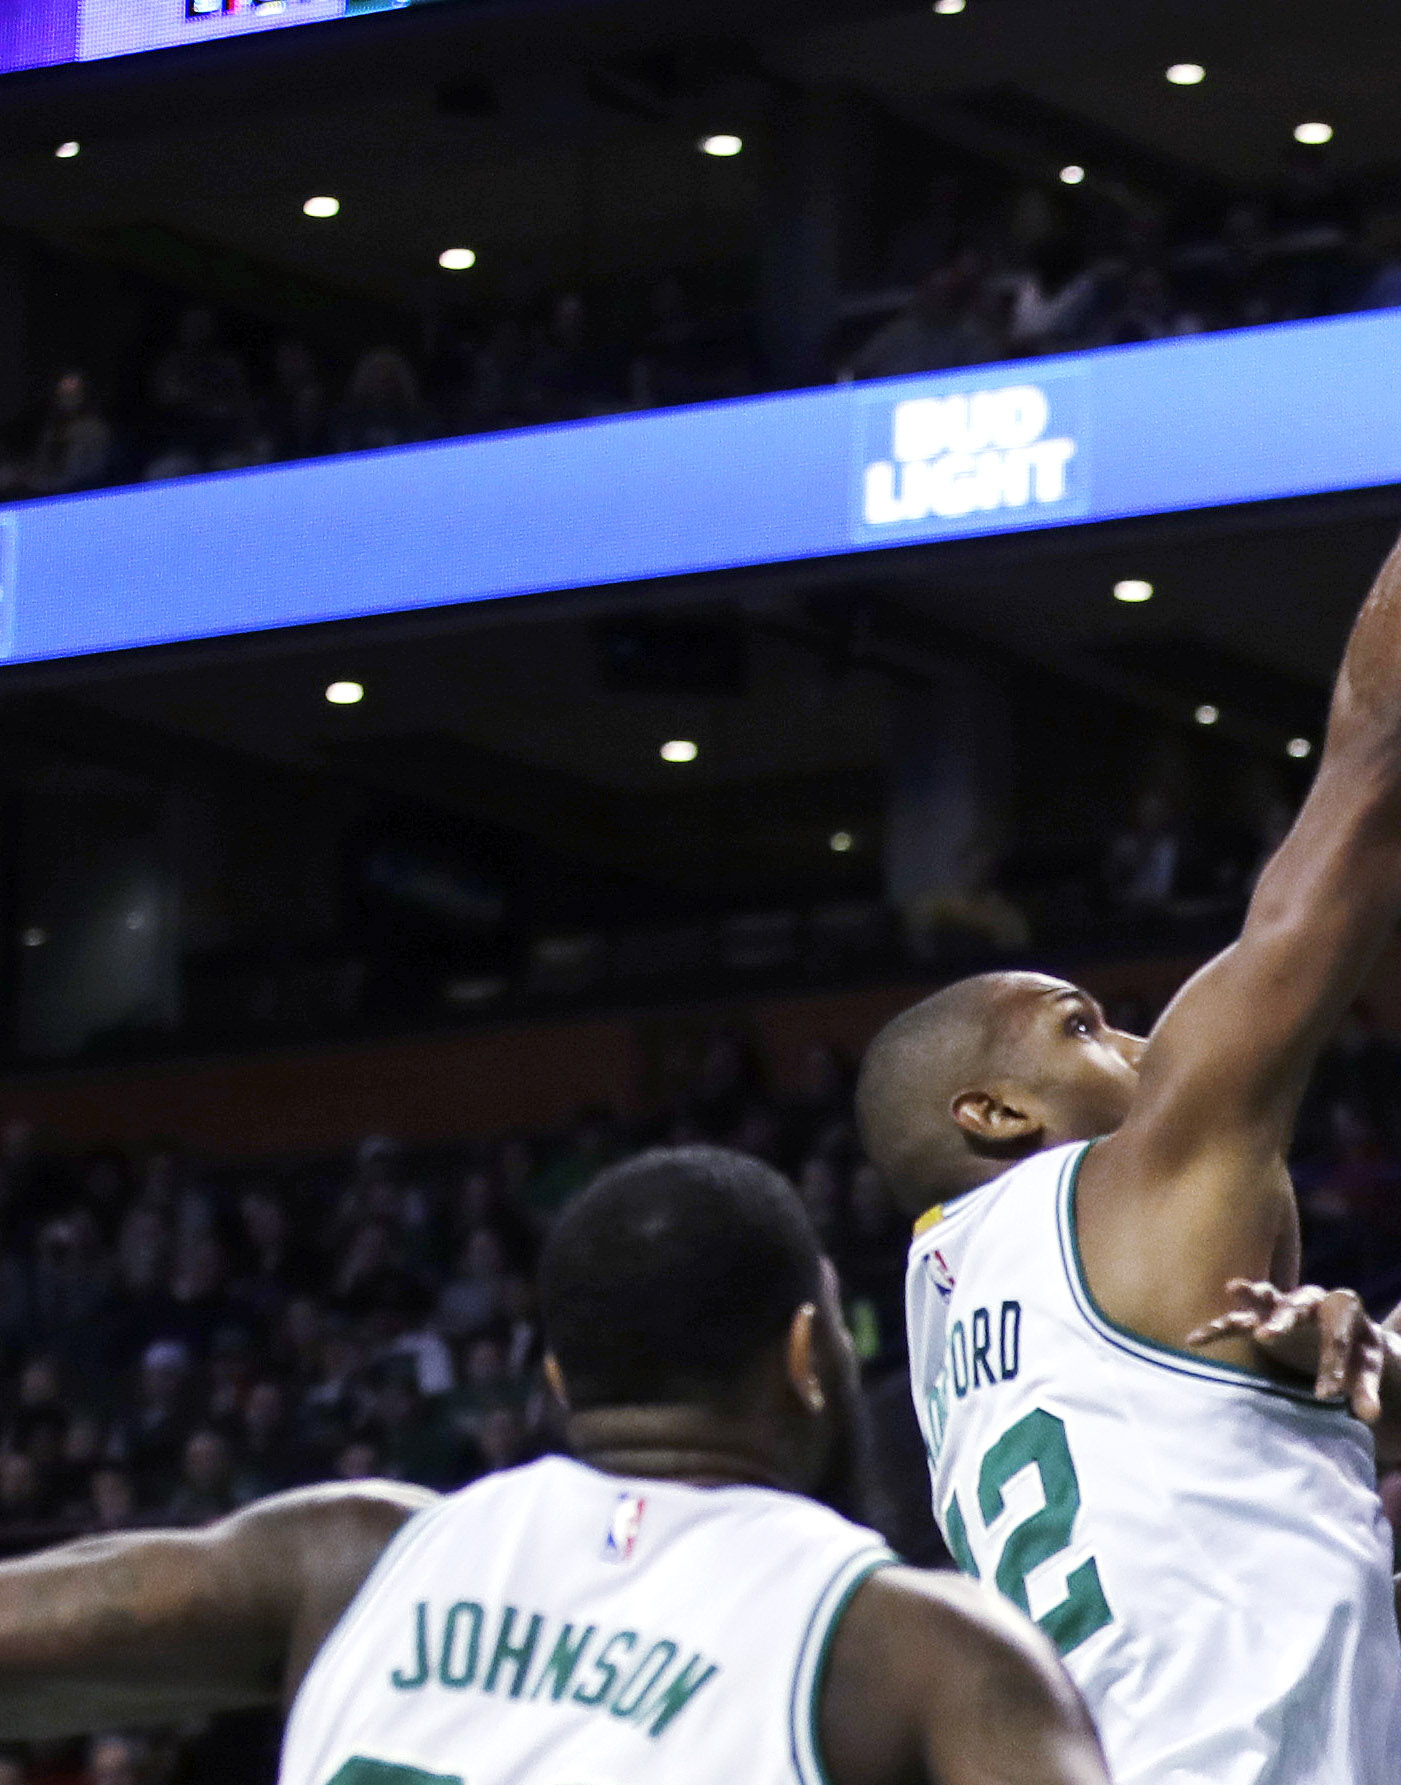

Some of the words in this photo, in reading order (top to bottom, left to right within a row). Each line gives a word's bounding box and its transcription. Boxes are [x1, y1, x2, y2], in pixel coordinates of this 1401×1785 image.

[893, 384, 1049, 463] BUD
[865, 437, 1077, 525] LIGHT
[391, 1599, 719, 1738] JOHNSON
